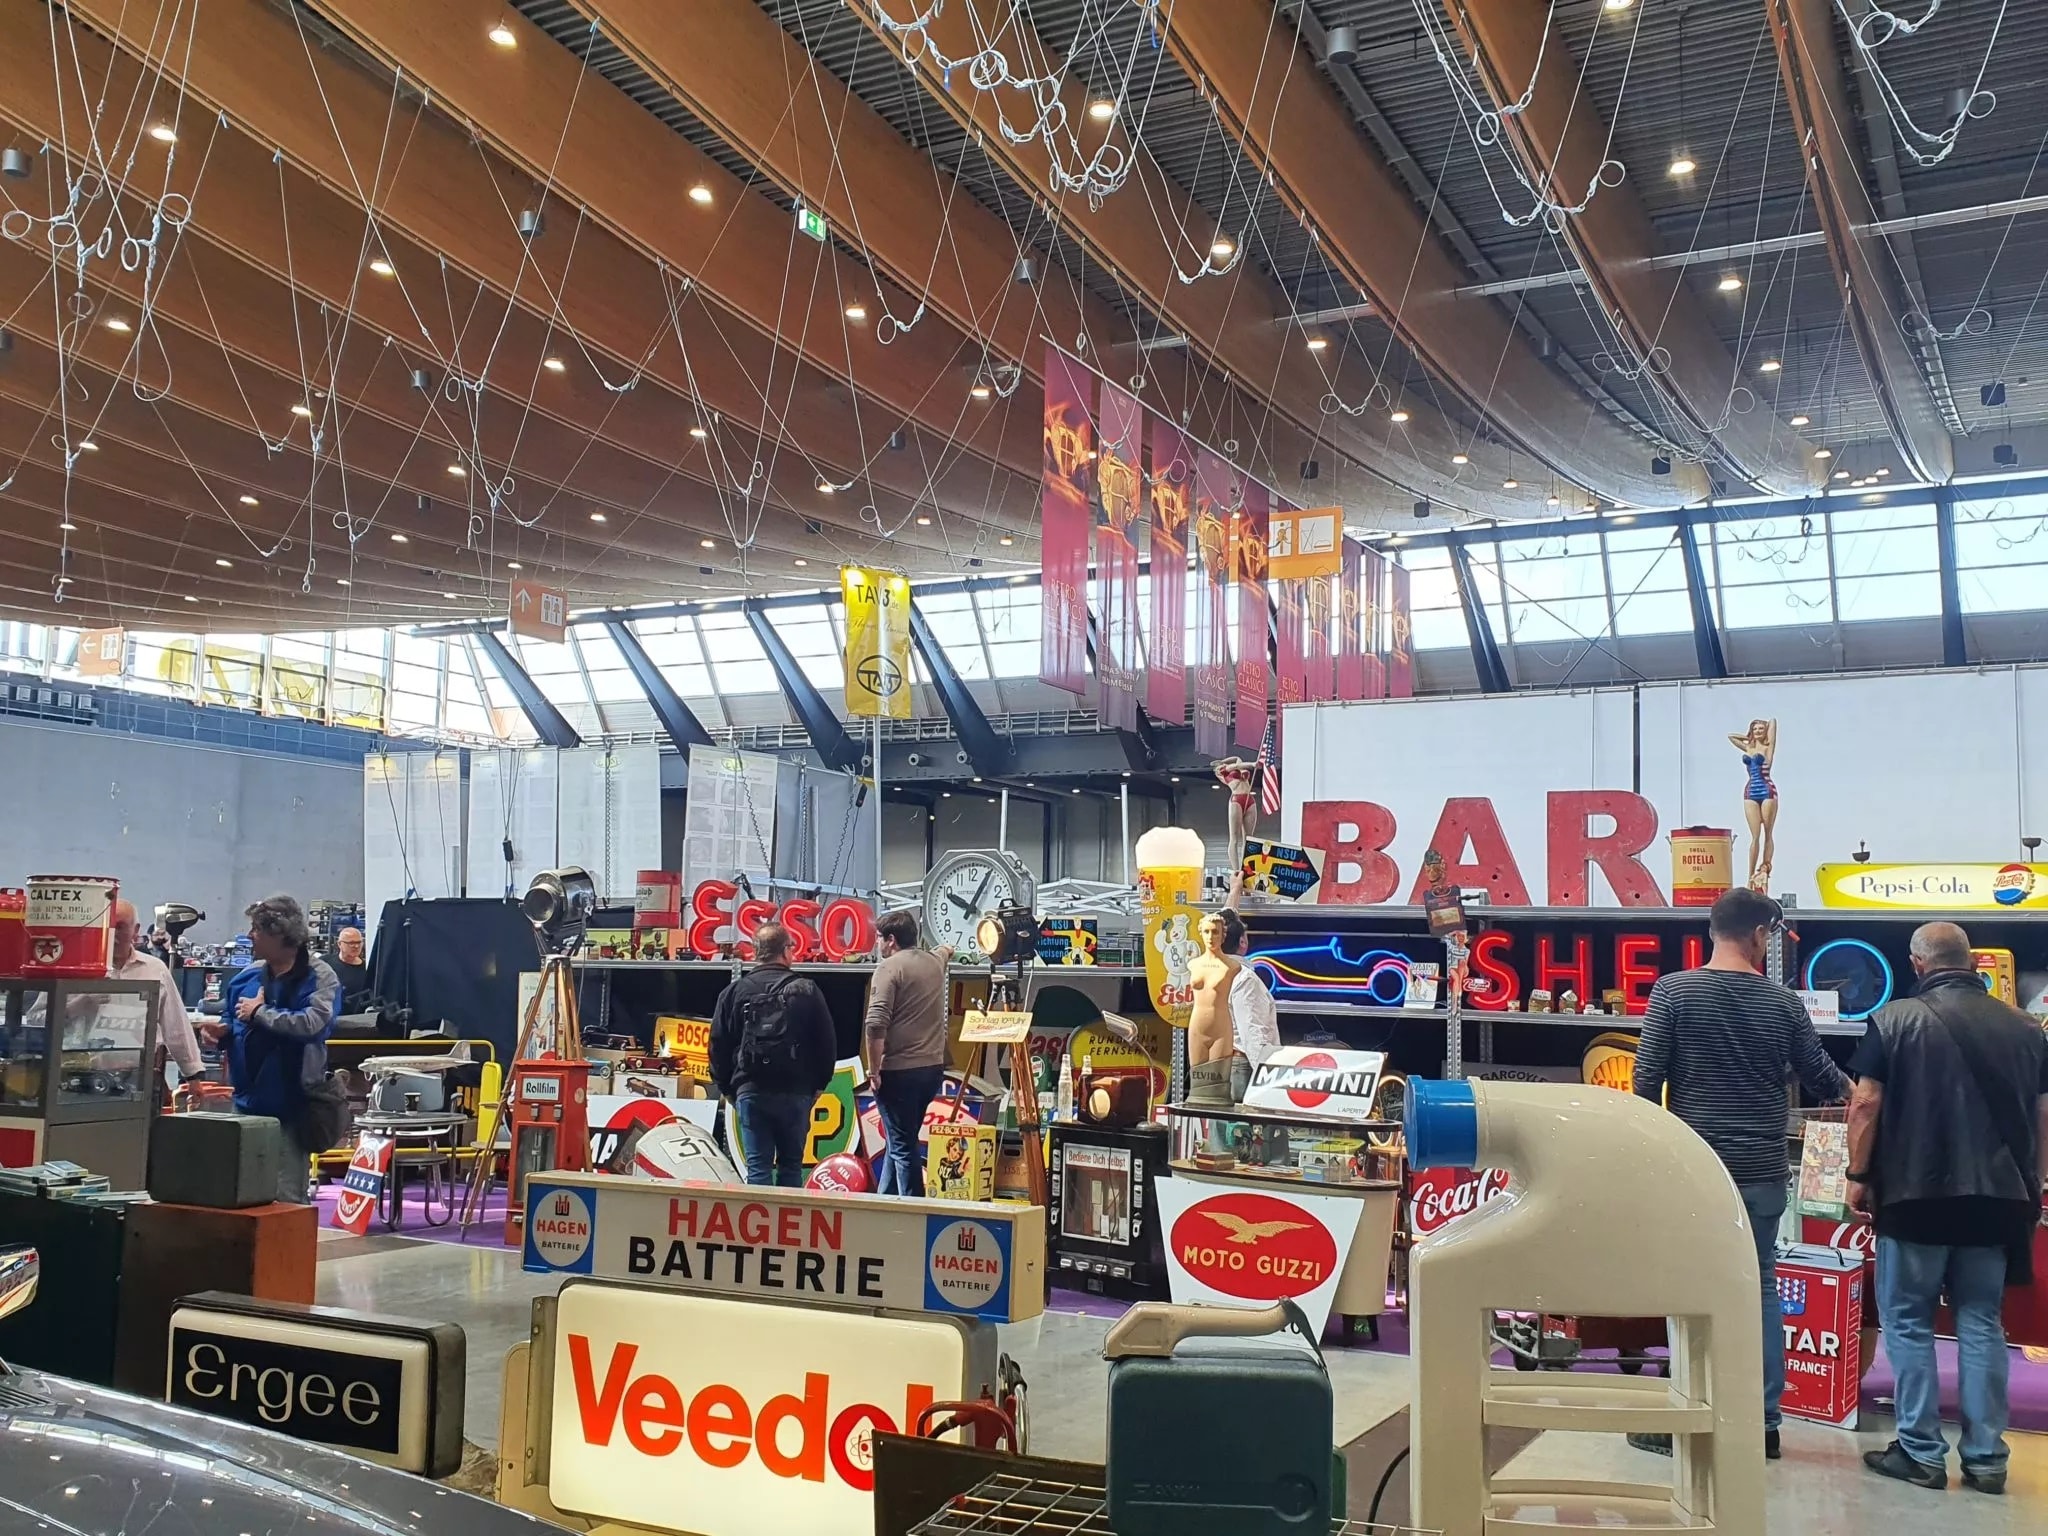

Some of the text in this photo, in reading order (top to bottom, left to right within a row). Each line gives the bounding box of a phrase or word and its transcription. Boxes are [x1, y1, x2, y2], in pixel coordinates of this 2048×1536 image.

[1276, 848, 1297, 860] NSU
[1301, 790, 1668, 907] BAR
[1682, 855, 1715, 865] ROTELLA
[956, 873, 964, 887] 11
[968, 868, 978, 882] 12
[30, 889, 82, 901] CALTEX
[994, 885, 1002, 899] 2
[1860, 876, 1971, 897] Pepsi-Cola
[940, 903, 948, 916] 9
[943, 918, 952, 933] 8
[1051, 920, 1069, 930] NSU
[955, 931, 963, 946] 7
[968, 936, 976, 950] 6
[1468, 929, 1703, 1015] SHE
[676, 1023, 710, 1046] BOSC
[525, 1079, 557, 1096] Rollfilm
[1256, 1065, 1371, 1096] MARTINI
[1597, 1080, 1631, 1091] SHE
[802, 1093, 842, 1164] P
[931, 1125, 960, 1135] PEZ-BOX
[669, 1136, 718, 1158] 31
[1068, 1150, 1127, 1168] Bediene Dich selbst
[1410, 1168, 1505, 1235] Coca-Co
[536, 1218, 588, 1236] HAGEN
[668, 1198, 843, 1250] HAGEN
[541, 1240, 581, 1252] BATTERIE
[628, 1236, 885, 1298] BATTERIE
[935, 1253, 999, 1274] HAGEN
[1183, 1244, 1321, 1282] MOTO GUZZI
[942, 1279, 991, 1292] BATTERIE
[1783, 1324, 1841, 1358] TAR
[1788, 1358, 1828, 1377] FRANCE
[185, 1343, 381, 1425] Ergee
